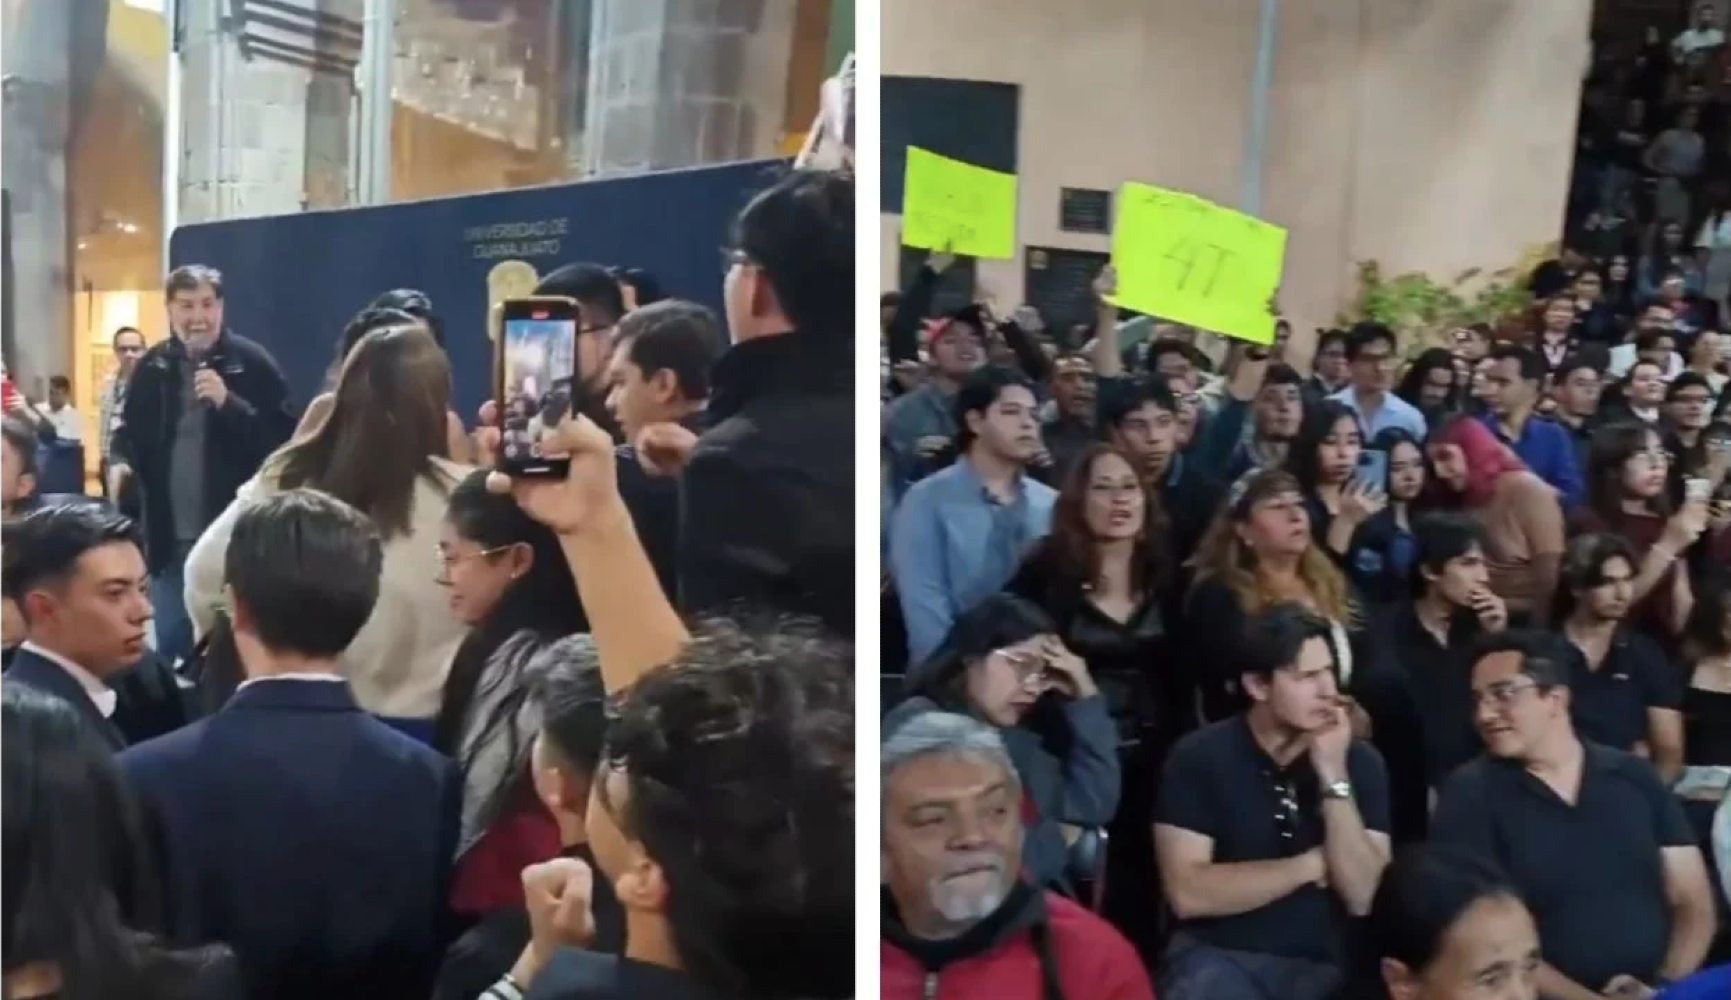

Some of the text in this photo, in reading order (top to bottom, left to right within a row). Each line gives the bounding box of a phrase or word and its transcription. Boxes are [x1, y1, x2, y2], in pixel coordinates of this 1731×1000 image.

[550, 216, 568, 235] DE
[473, 239, 560, 259] GUANAJUATO
[1163, 236, 1236, 298] 4T
